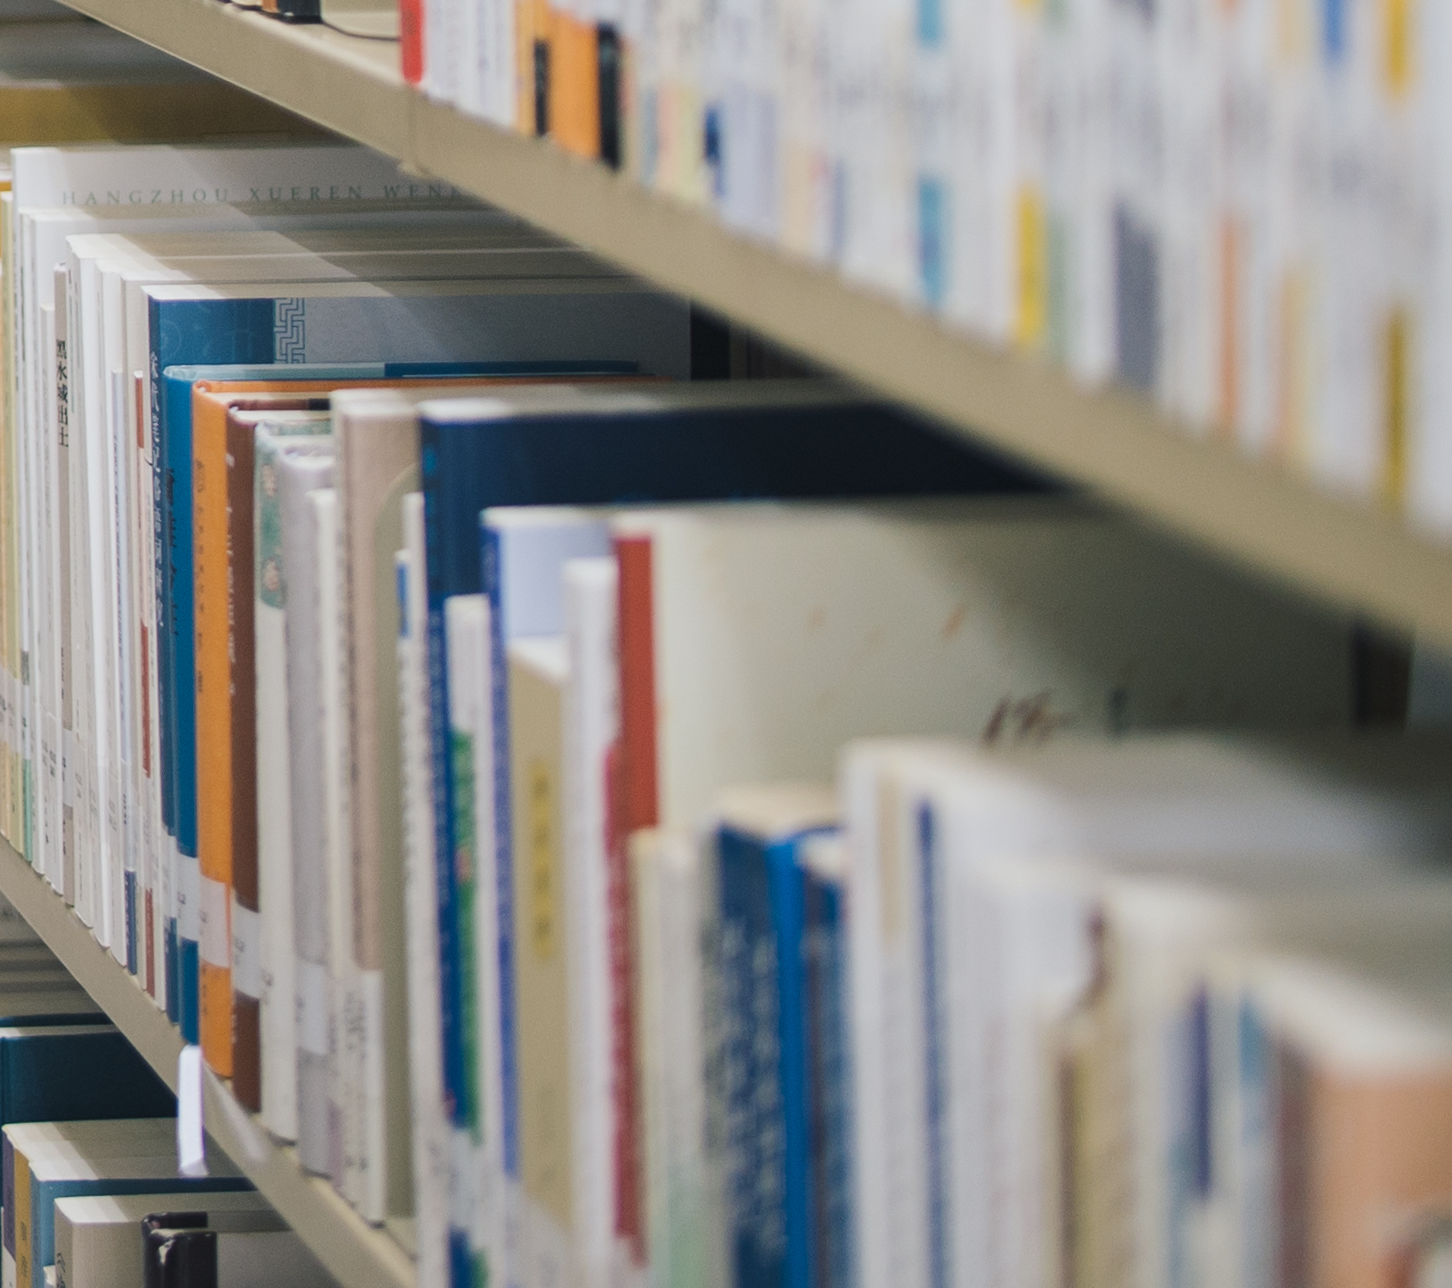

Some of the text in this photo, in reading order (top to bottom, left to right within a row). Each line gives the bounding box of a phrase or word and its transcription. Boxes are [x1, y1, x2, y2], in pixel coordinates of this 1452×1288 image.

[61, 186, 230, 207] HANGZHOU
[248, 184, 364, 203] XUEREN
[55, 338, 71, 448] 黑水城出土
